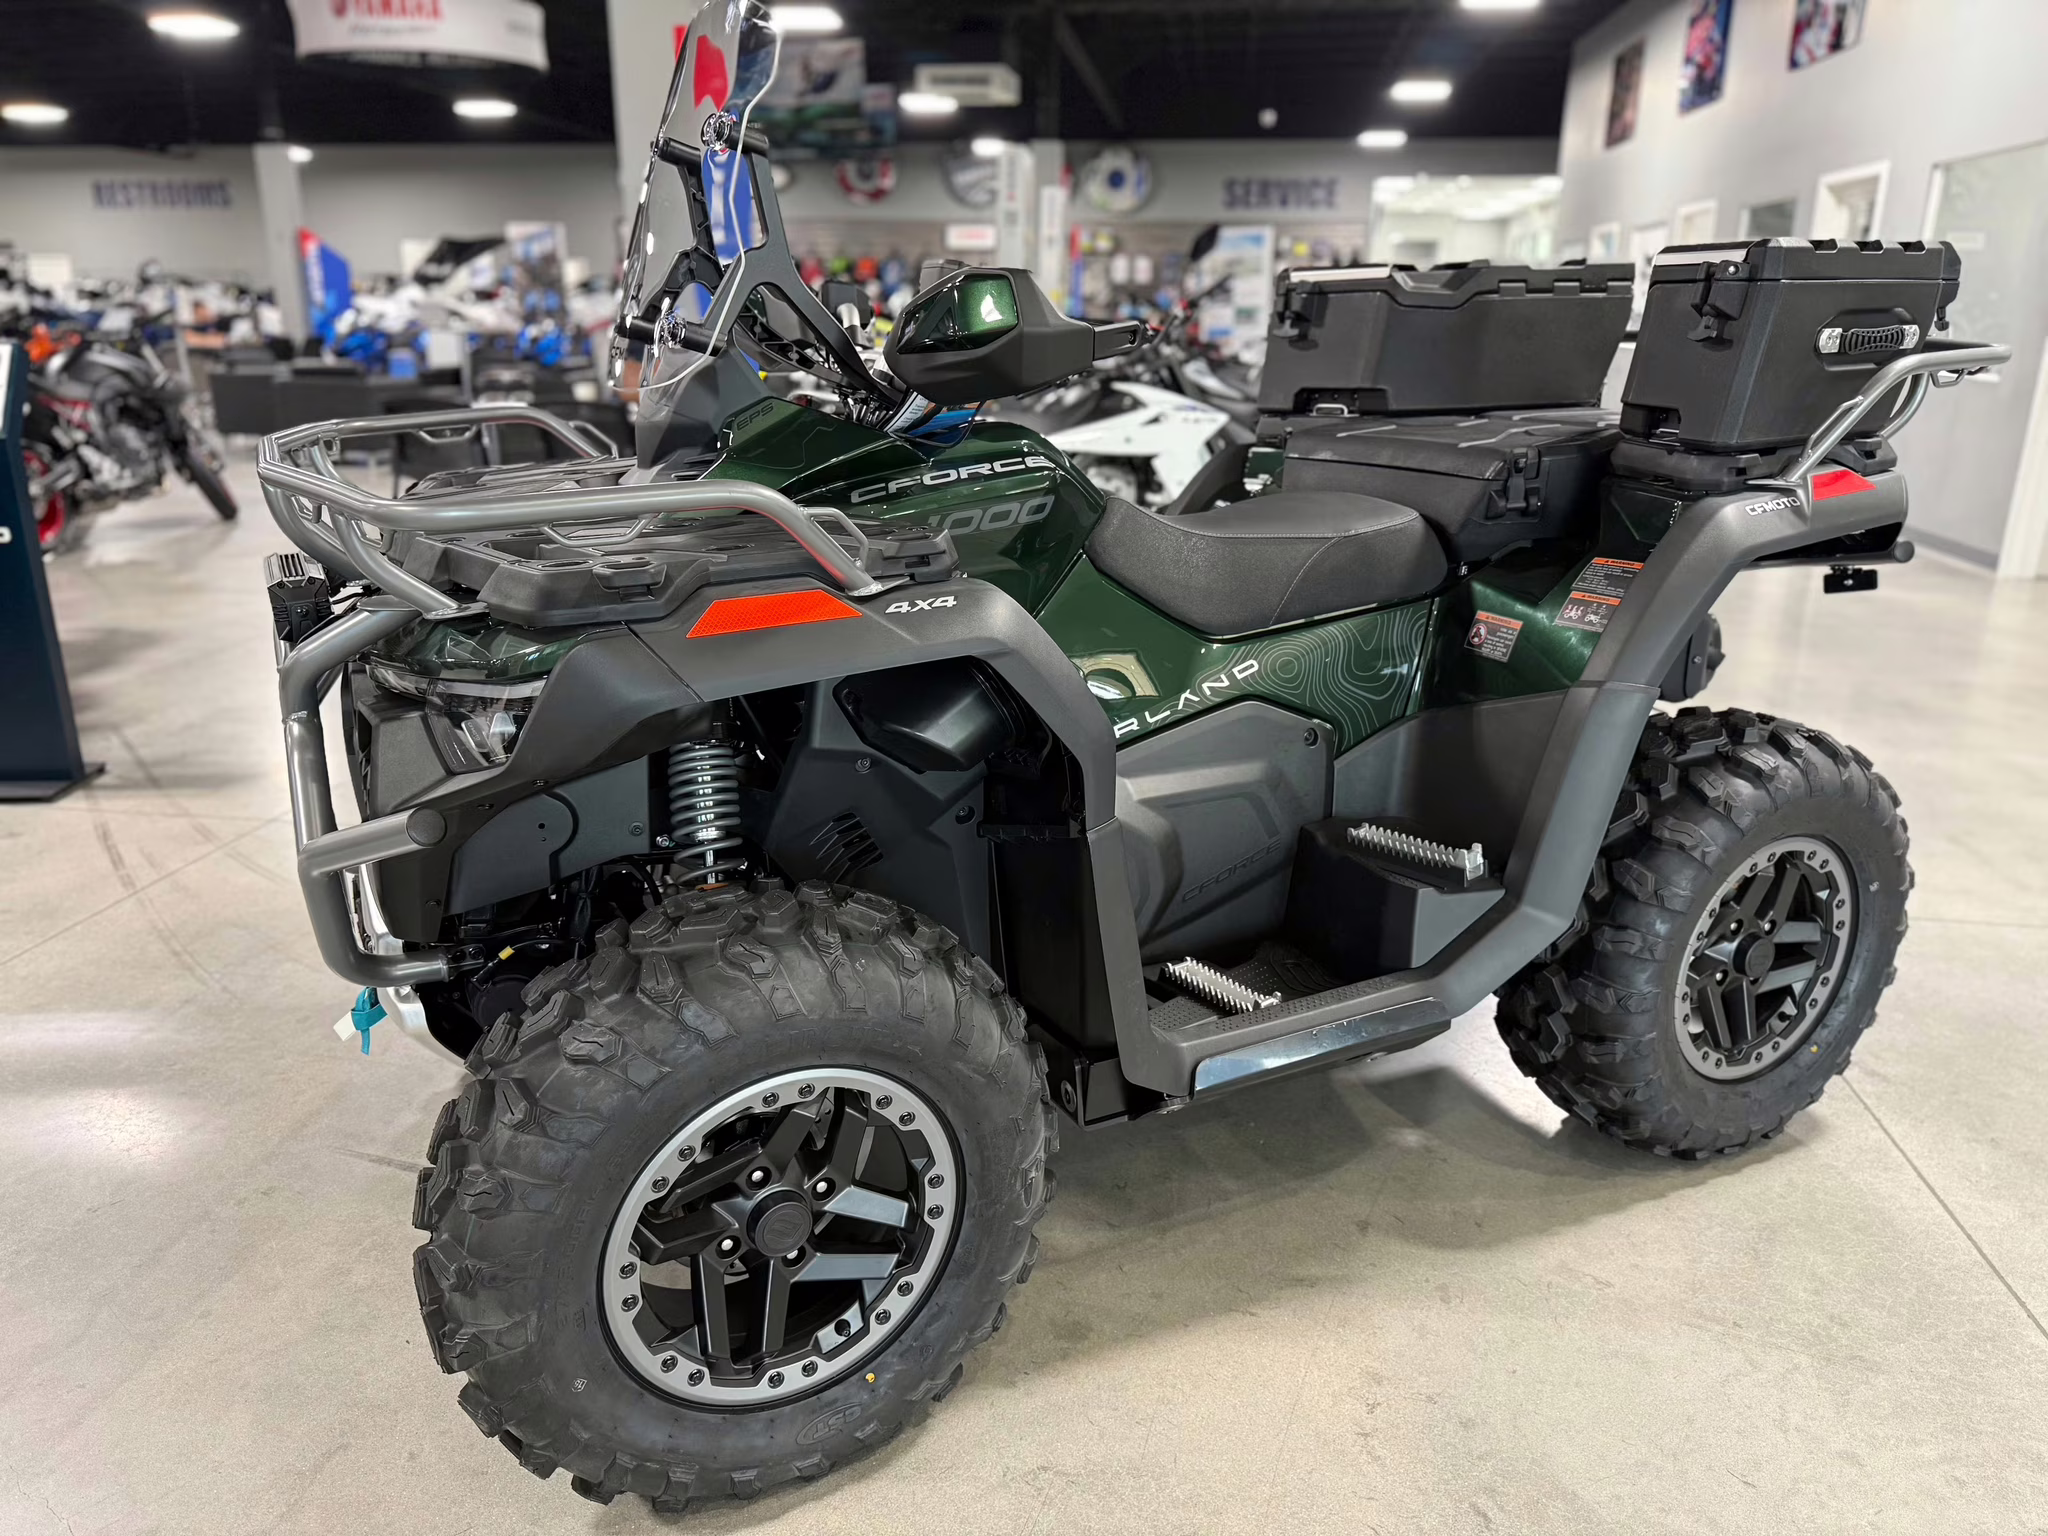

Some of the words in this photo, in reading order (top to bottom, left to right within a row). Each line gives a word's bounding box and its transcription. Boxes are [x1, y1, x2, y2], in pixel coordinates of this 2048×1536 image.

[93, 180, 232, 209] RESTROOMS
[1223, 177, 1340, 211] SERVICE
[736, 402, 773, 431] EPS
[851, 456, 1055, 503] CFORCE
[1745, 497, 1800, 516] CFMOTO
[885, 595, 957, 613] 4X4
[1113, 660, 1259, 739] RLAND
[1182, 838, 1283, 902] CFORCE
[812, 1406, 862, 1440] CST
